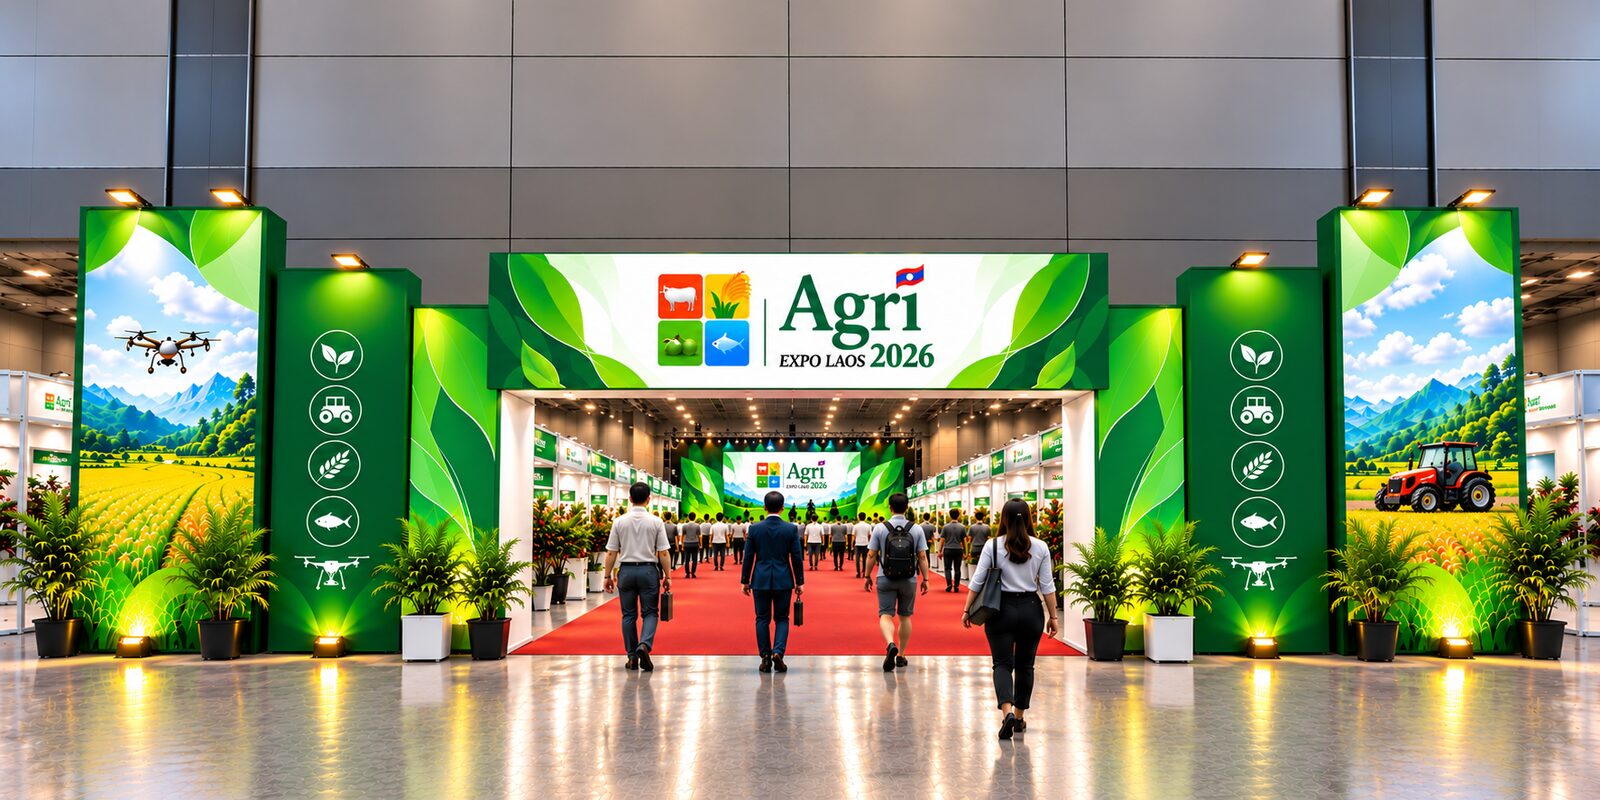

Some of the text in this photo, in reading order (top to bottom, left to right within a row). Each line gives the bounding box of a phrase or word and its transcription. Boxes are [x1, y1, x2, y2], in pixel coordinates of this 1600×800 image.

[778, 274, 922, 351] Agri
[778, 343, 935, 368] EXPO LAOS 2026
[786, 462, 824, 484] Agri
